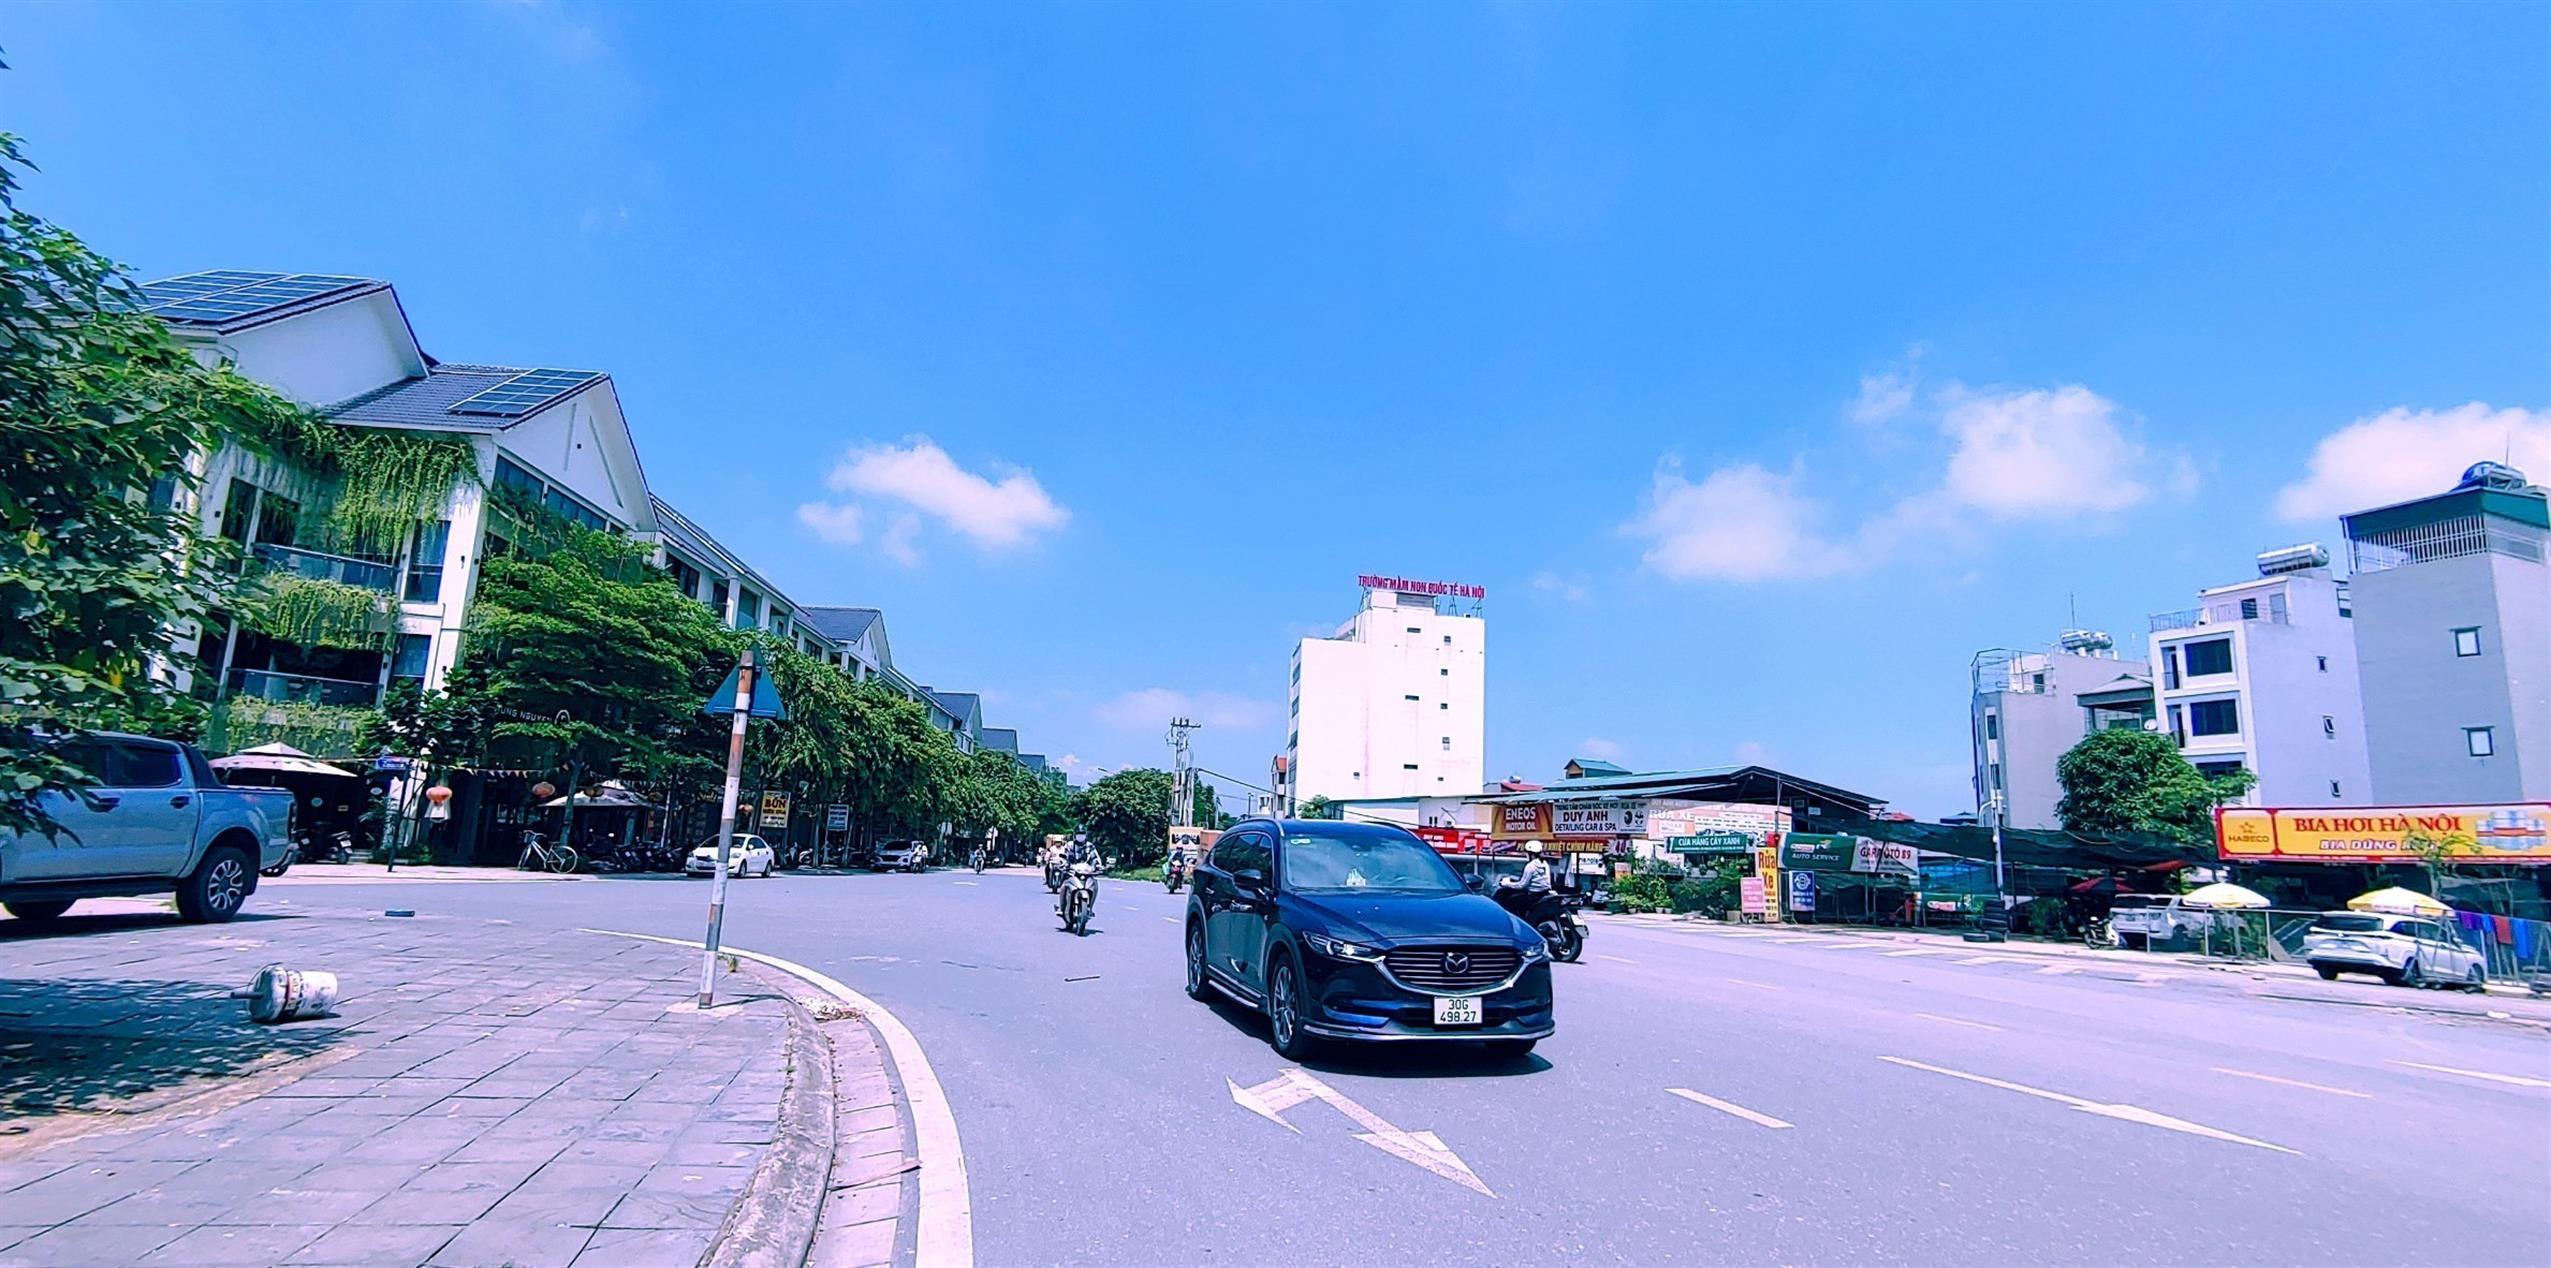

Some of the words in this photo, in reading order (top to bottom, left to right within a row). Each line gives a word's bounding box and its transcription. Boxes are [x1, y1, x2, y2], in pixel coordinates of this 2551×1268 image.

[1358, 574, 1387, 589] TRƯỜNG
[1411, 583, 1427, 593] NON
[1460, 584, 1470, 597] HÀ
[1472, 585, 1485, 599] NỘI
[1505, 806, 1536, 820] ENEOS
[1563, 811, 1583, 822] DUY
[1586, 810, 1608, 822] ANH
[1505, 821, 1526, 831] MOTOR
[1526, 821, 1537, 830] OIL
[1554, 823, 1584, 832] DETAILING
[1585, 823, 1598, 832] CAR
[1599, 822, 1603, 832] &
[1604, 822, 1617, 832] SPA
[2294, 817, 2329, 832] BIA
[2332, 817, 2376, 832] HƠI
[2377, 813, 2411, 832] HÀ
[2416, 812, 2464, 836] NỘI
[1691, 836, 1709, 846] HÀNG
[1710, 836, 1723, 846] CÂY
[1722, 837, 1741, 846] XANH
[2228, 835, 2270, 843] HABECO
[2319, 839, 2347, 850] BIA
[1758, 850, 1776, 870] Rửa
[1791, 852, 1810, 860] AUTO
[1812, 853, 1840, 861] SERVICE
[1901, 849, 1911, 860] 89
[1762, 872, 1774, 889] Xe
[1448, 999, 1469, 1010] 30G
[1440, 1011, 1477, 1022] 498.27
